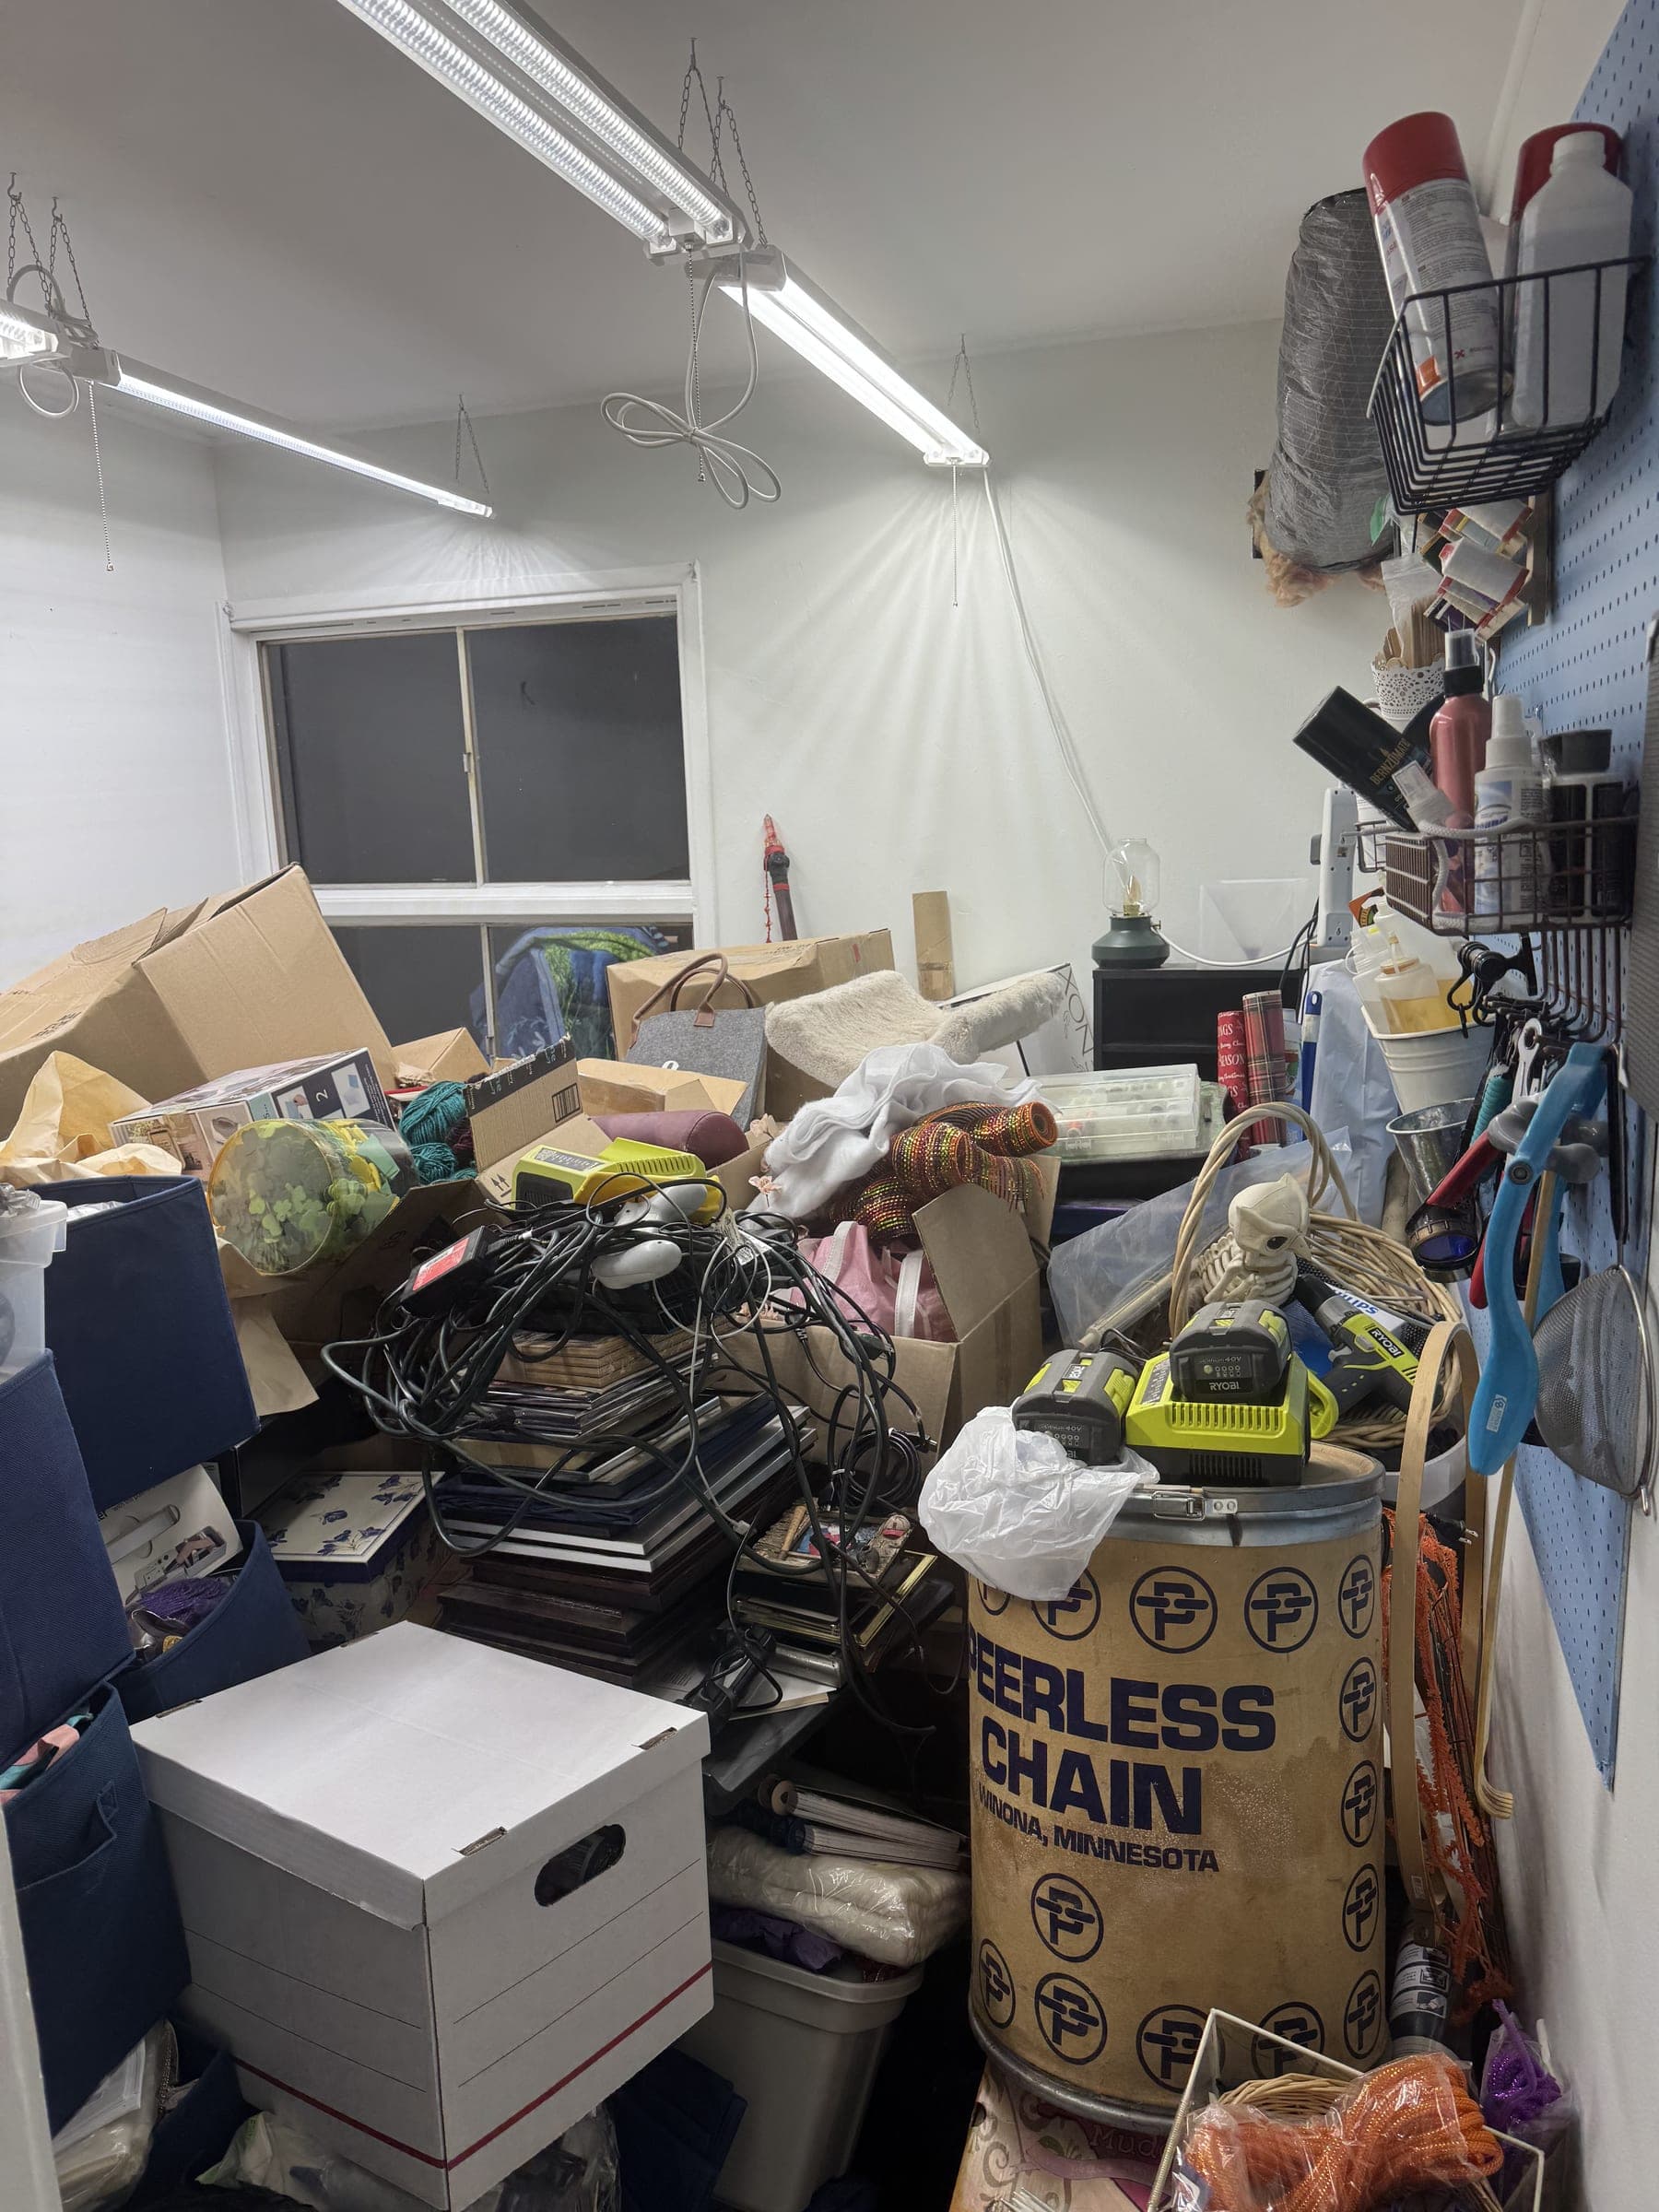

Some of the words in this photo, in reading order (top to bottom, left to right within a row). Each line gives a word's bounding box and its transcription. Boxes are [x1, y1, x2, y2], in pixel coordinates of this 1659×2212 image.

[315, 1088, 329, 1102] 2
[1371, 1329, 1402, 1357] RYOBI
[1209, 1382, 1240, 1391] RYOBI
[970, 1623, 1277, 1752] PEERLESS
[982, 1715, 1202, 1835] CHAIN
[979, 1782, 1048, 1847] WINONA,
[1053, 1826, 1219, 1873] MINNESOTA
